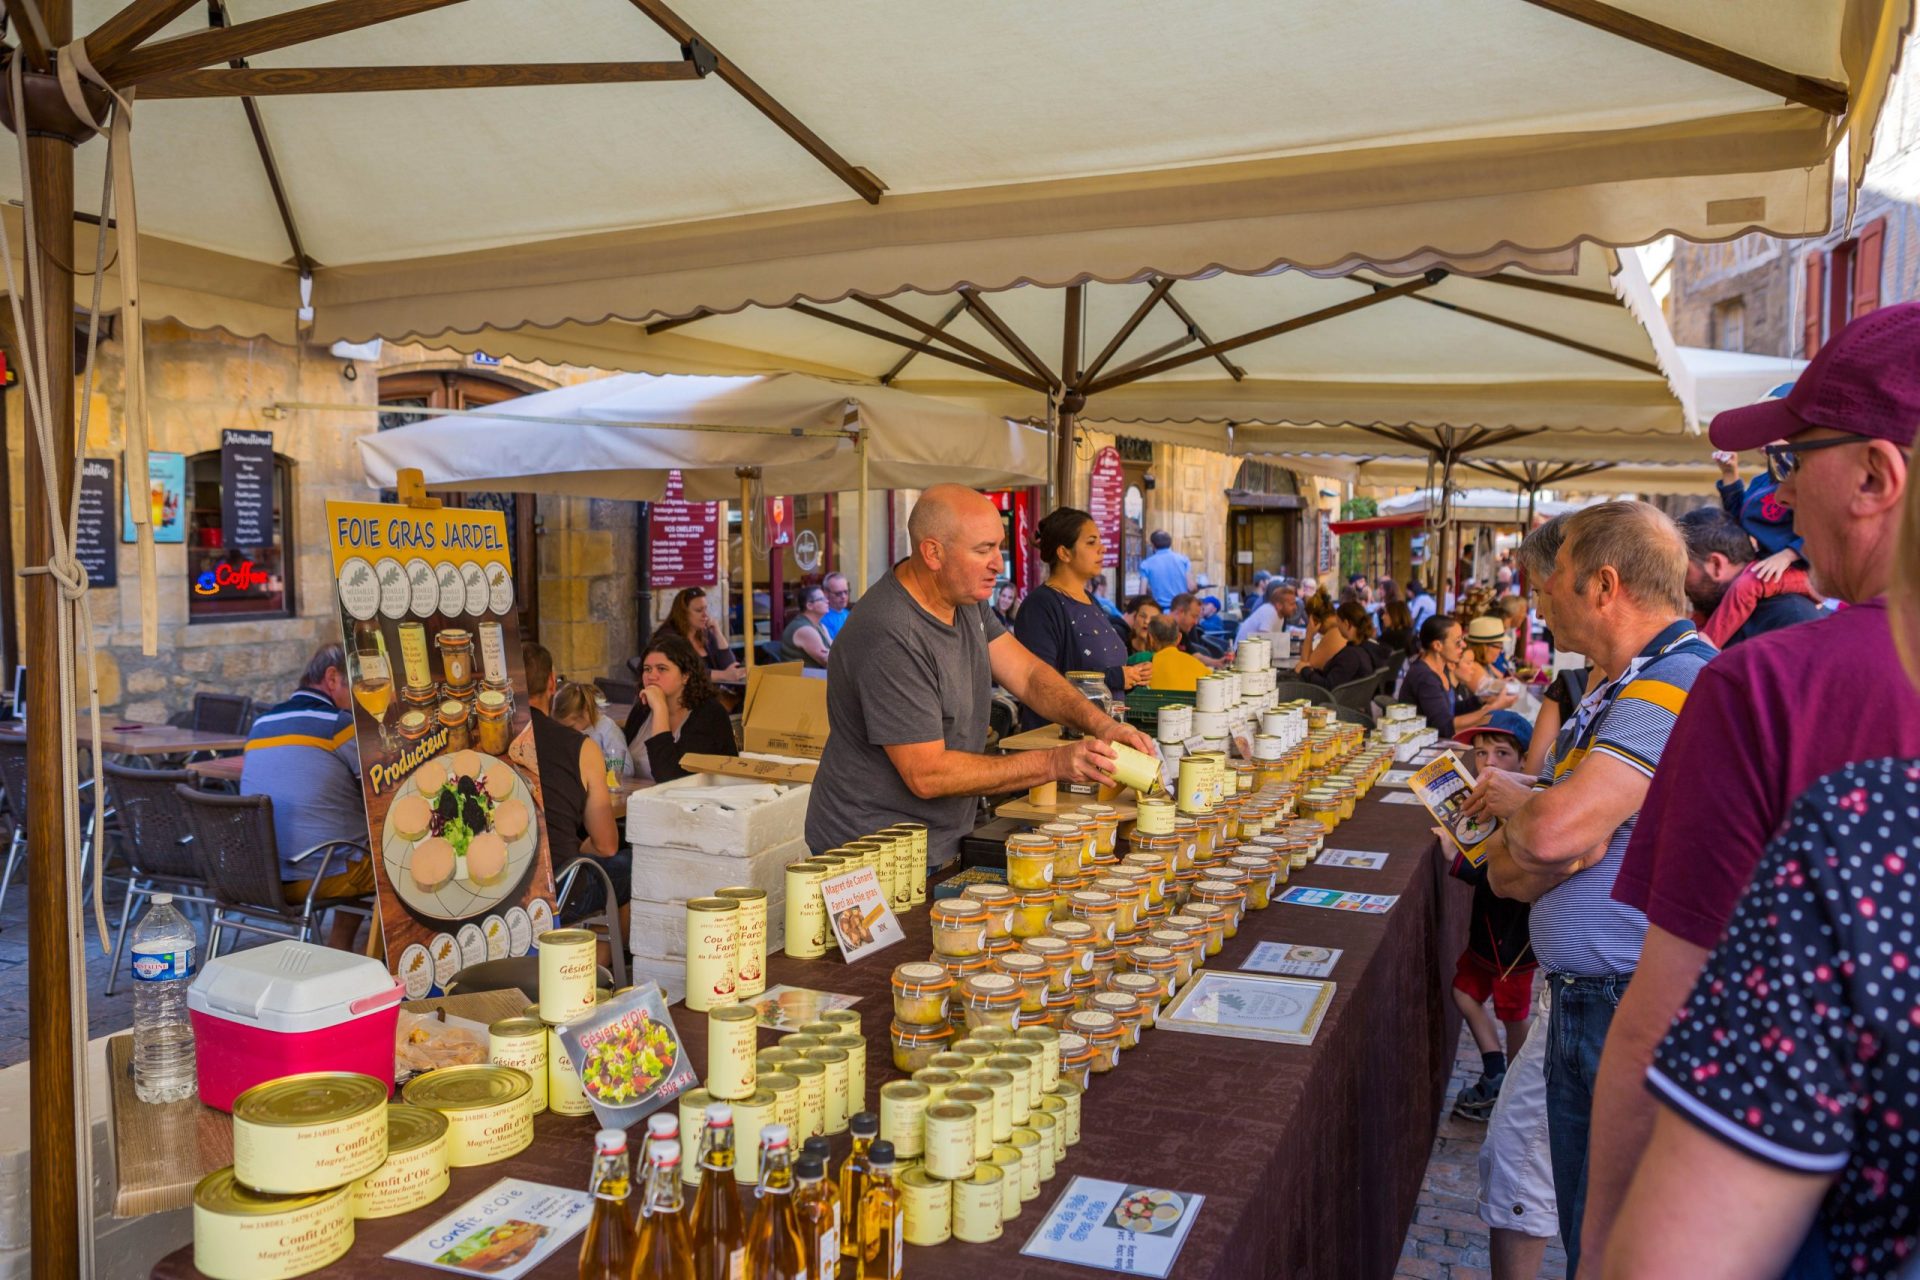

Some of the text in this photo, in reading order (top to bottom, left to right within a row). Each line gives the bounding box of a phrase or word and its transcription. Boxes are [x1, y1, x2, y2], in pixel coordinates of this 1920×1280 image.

[337, 517, 503, 550] FOIE GRAS JARDEL
[216, 562, 269, 590] Coffee
[369, 727, 449, 794] Producteur
[824, 871, 874, 897] Magret de Canard
[831, 897, 846, 911] Farci
[846, 896, 855, 905] au
[853, 890, 866, 904] foie
[865, 887, 879, 901] gras
[703, 932, 739, 944] Cou d'O
[559, 963, 593, 975] Gésiers
[579, 1008, 649, 1050] Gésiers d'Oie
[493, 1056, 527, 1067] Gésiers
[530, 1053, 546, 1065] d'O
[657, 1081, 678, 1098] 350g
[678, 1073, 686, 1086] 9
[465, 1113, 488, 1121] JARDEL
[298, 1131, 313, 1140] Jean
[313, 1127, 340, 1139] JARDEL
[483, 1123, 513, 1136] Confit
[335, 1135, 368, 1154] Confit
[467, 1137, 495, 1147] Magret,
[315, 1156, 347, 1168] Magret,
[364, 1167, 430, 1189] Confit d'Oie
[353, 1191, 378, 1199] agret,
[380, 1183, 416, 1197] Manchon
[240, 1222, 254, 1231] Jean
[256, 1220, 285, 1230] JARDEL
[428, 1189, 524, 1250] Confit d'Oie
[279, 1217, 346, 1247] Confit d'Oie
[257, 1249, 295, 1261] Magret,
[297, 1235, 332, 1253] Manchon
